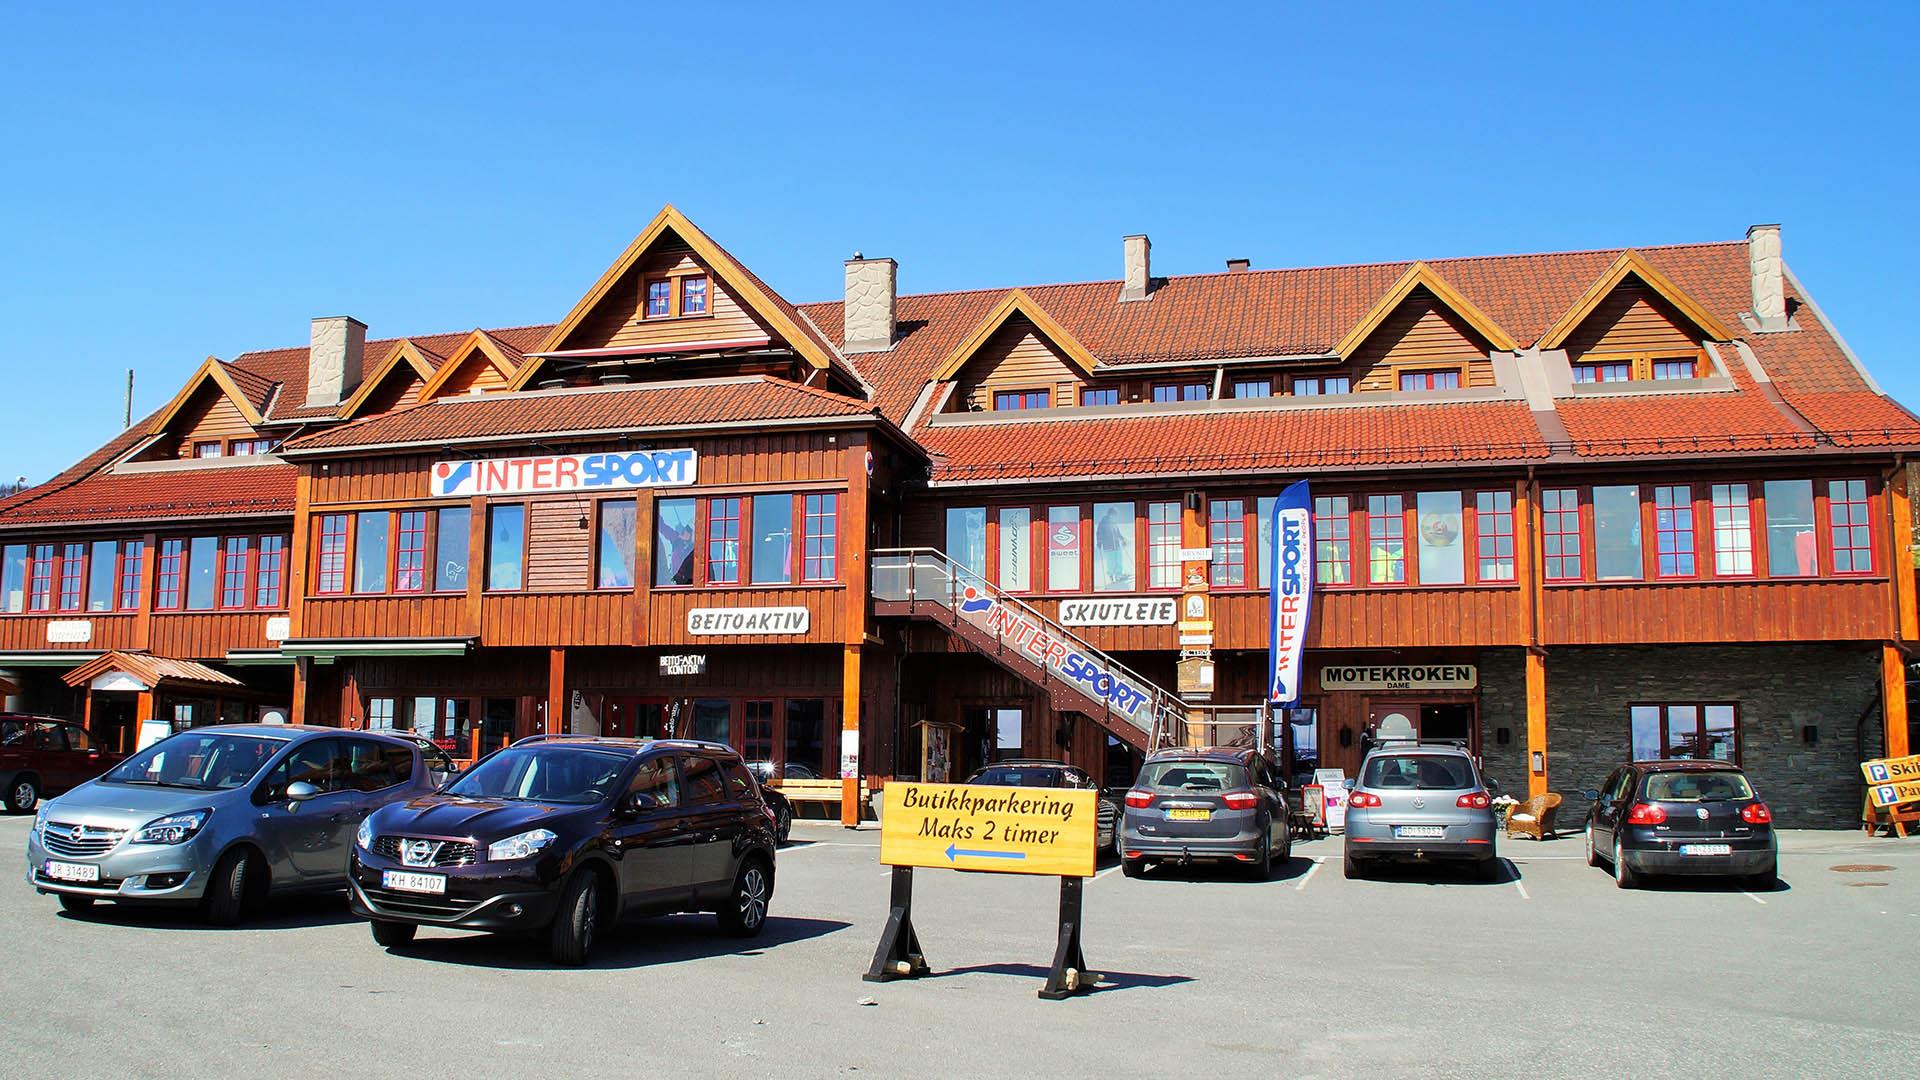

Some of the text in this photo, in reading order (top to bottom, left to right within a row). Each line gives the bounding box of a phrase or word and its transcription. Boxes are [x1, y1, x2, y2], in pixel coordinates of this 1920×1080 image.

[477, 450, 692, 491] INTERSPORT
[691, 612, 804, 630] BEITOAKTIV
[1064, 603, 1172, 622] SKIUTLEIE
[660, 655, 705, 666] BEITO-AKTIV
[987, 605, 1147, 715] INTERSPORT
[667, 664, 699, 675] KONTOR
[1326, 667, 1470, 682] MOTEKROKEN
[903, 787, 1074, 821] Butikkparkering
[918, 817, 1060, 844] Maks 2 timer
[53, 864, 95, 878] JR 31489
[391, 873, 442, 890] KH 84107
